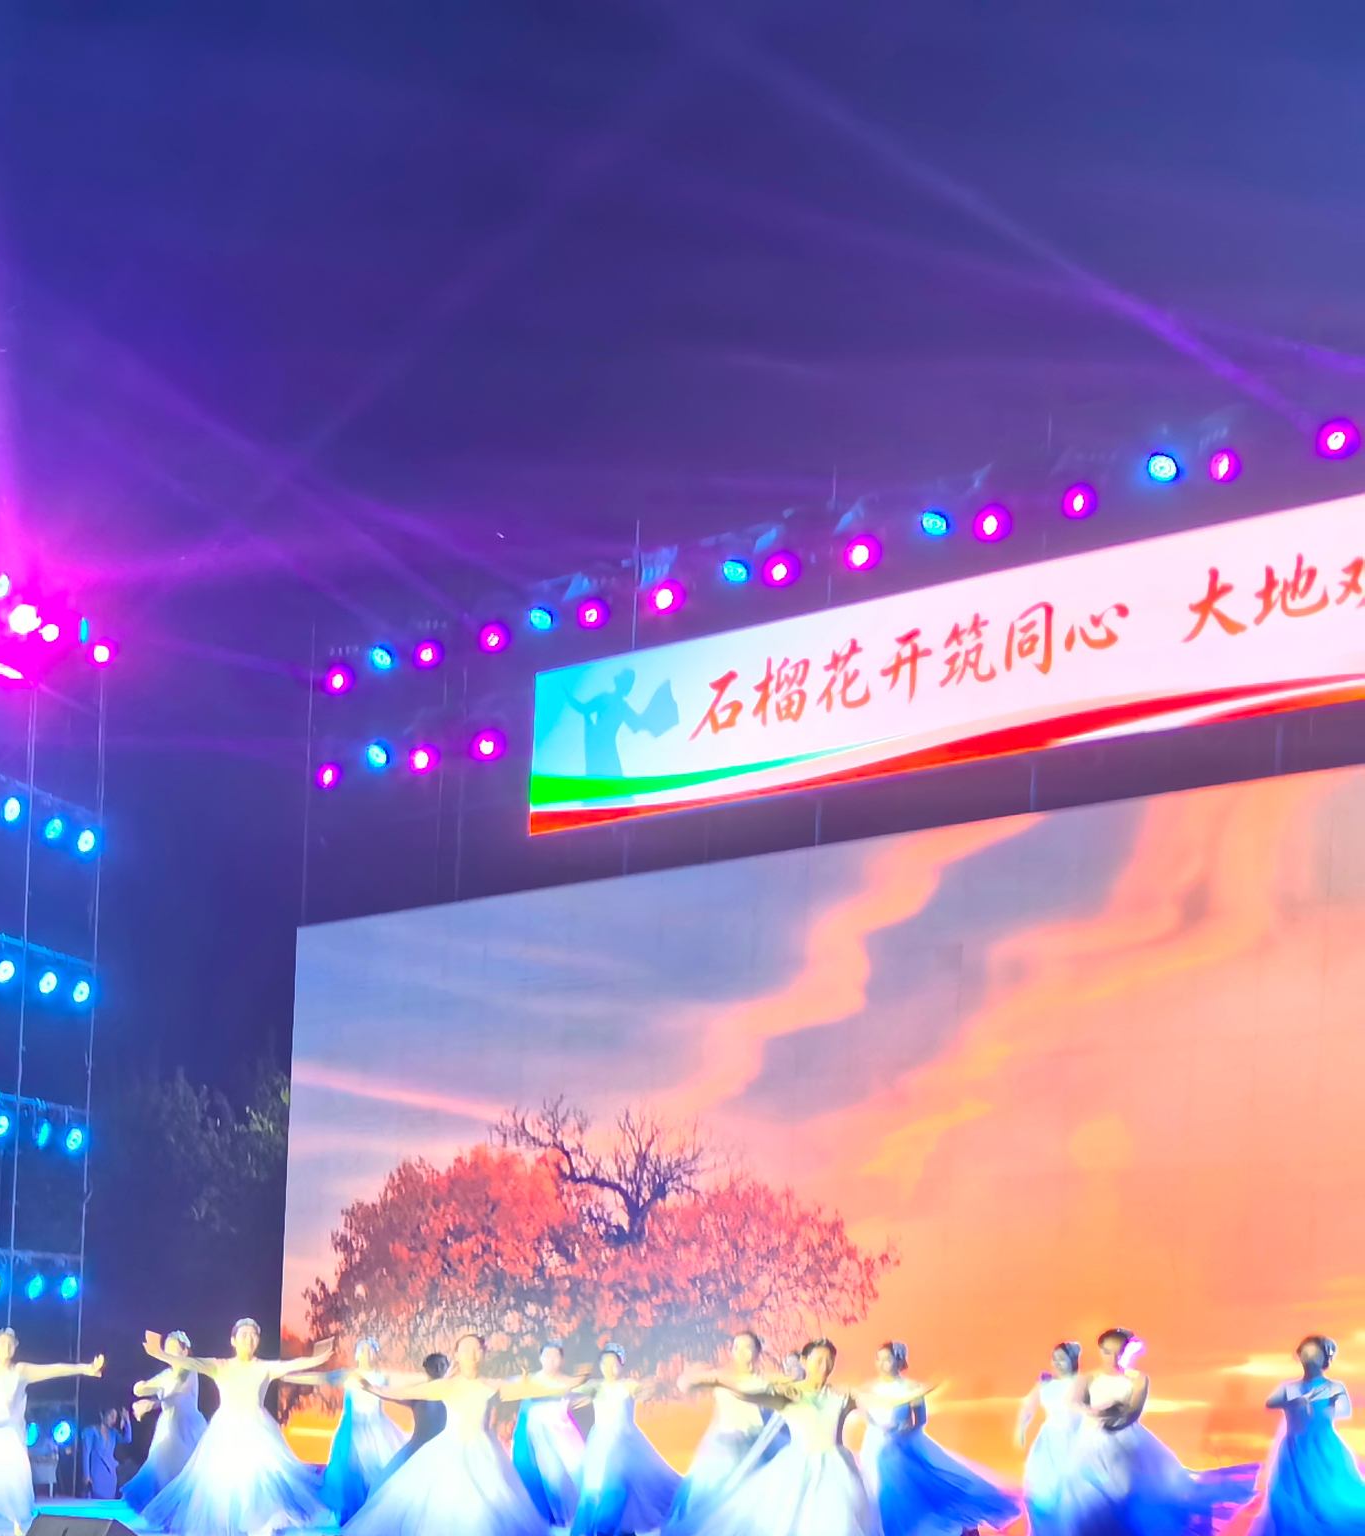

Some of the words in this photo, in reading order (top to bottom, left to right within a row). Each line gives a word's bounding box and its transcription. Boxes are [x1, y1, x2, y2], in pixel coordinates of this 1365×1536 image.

[690, 602, 1130, 740] 石榴花开筑同心
